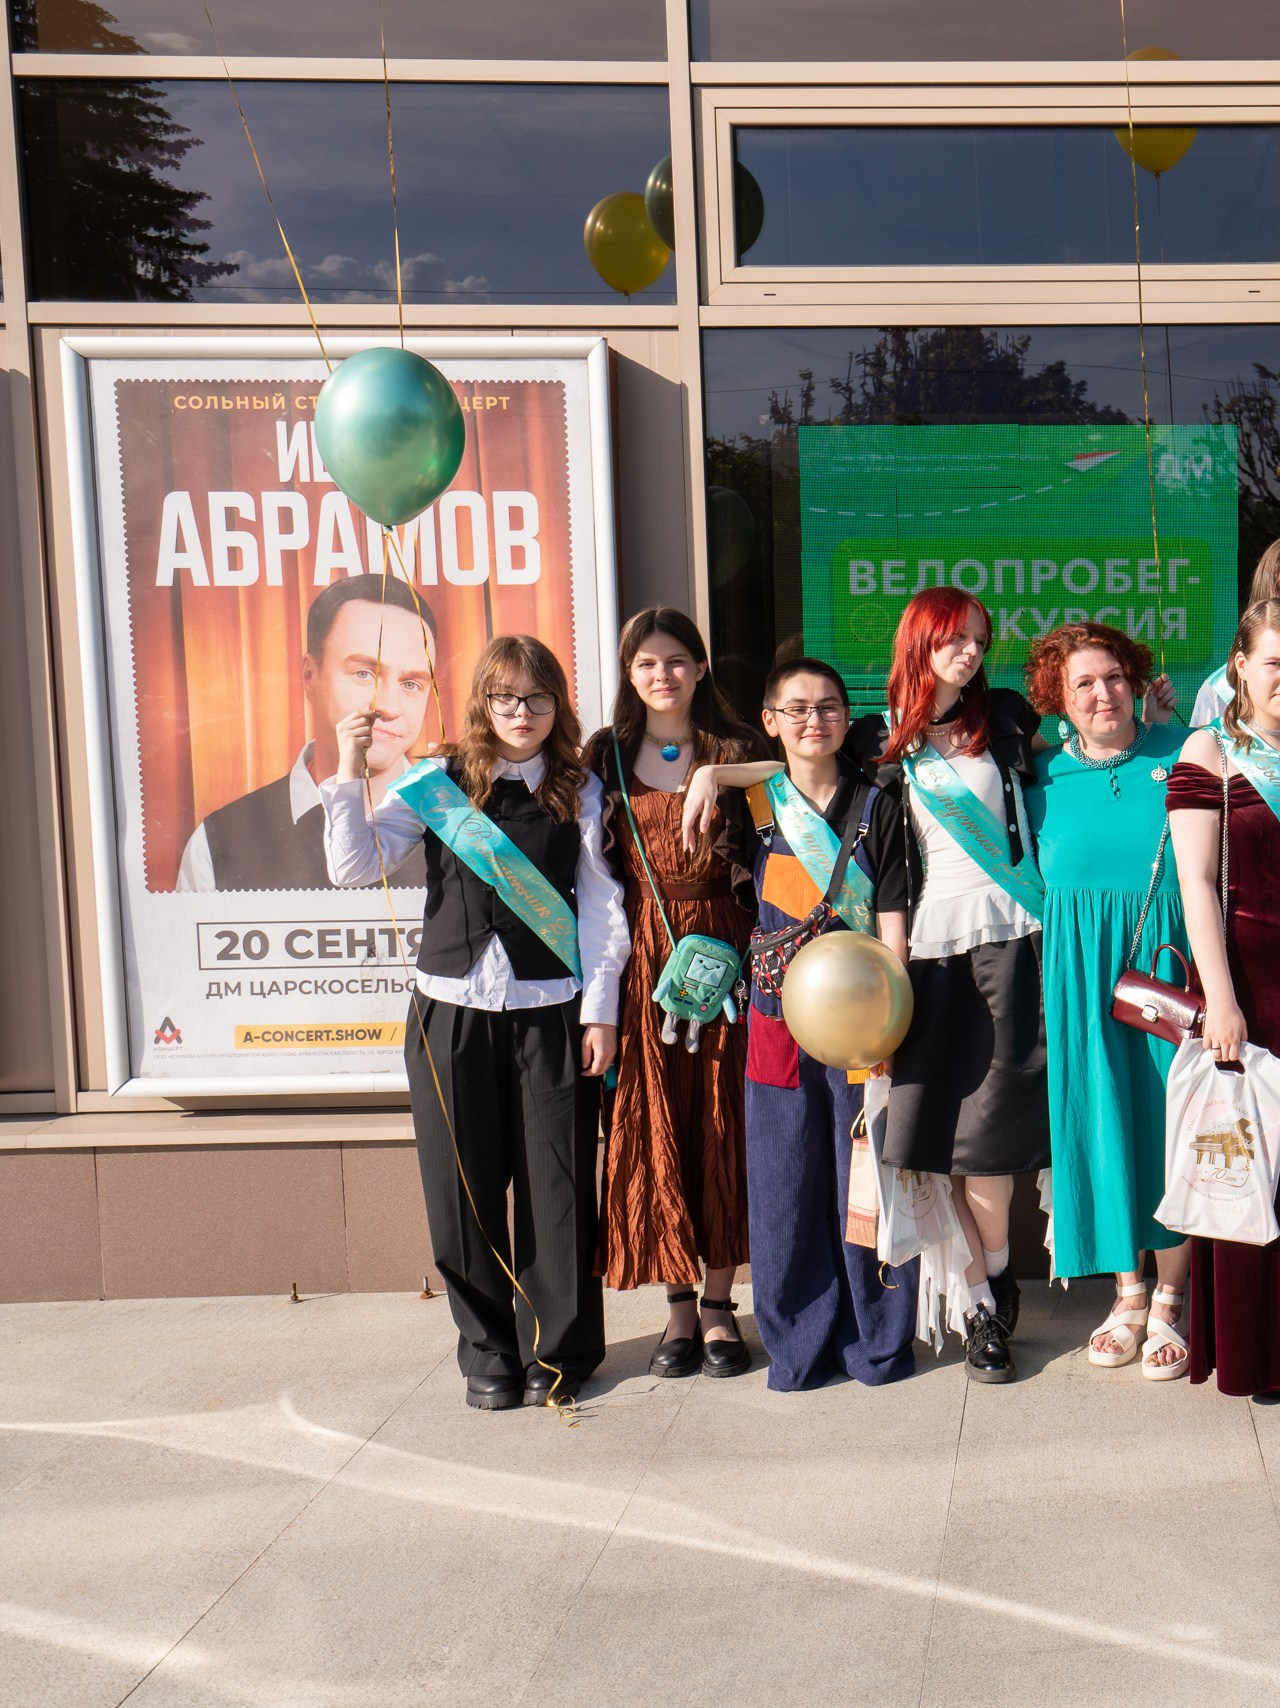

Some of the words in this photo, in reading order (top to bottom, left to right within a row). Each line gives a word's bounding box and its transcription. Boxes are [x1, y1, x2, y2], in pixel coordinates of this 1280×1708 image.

[174, 393, 286, 411] СОЛЬНЫЙ
[464, 396, 510, 410] ЦЕРТ
[155, 490, 541, 587] АБРАМОВ
[849, 558, 1200, 595] ВЕЛОПРОБЕГ-
[214, 929, 270, 961] 20
[284, 927, 423, 960] СЕНТЯ
[205, 981, 242, 1000] ДМ
[249, 977, 417, 999] ЦАРСКОСЕЛЬС
[243, 1028, 383, 1044] A-CONCERT.SHOW
